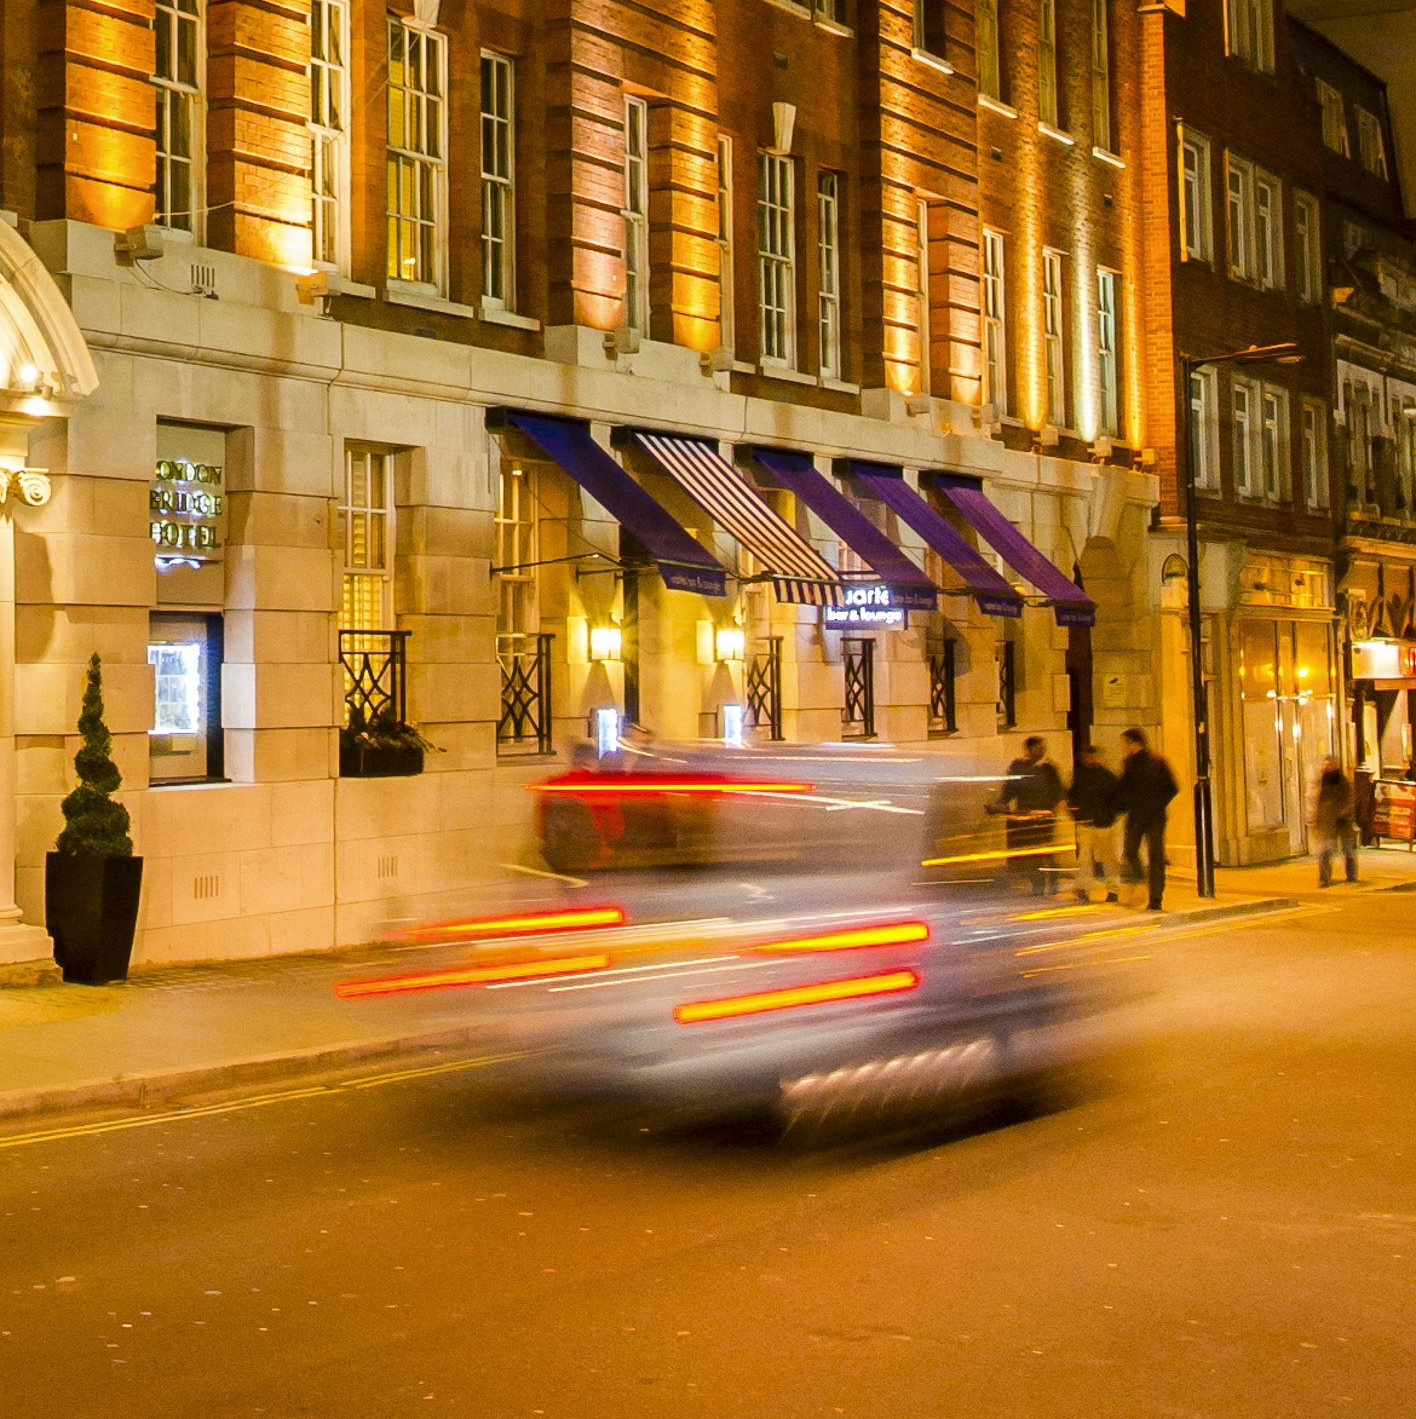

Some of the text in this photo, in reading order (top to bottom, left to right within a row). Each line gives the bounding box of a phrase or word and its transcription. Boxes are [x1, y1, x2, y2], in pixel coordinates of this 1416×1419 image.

[155, 460, 223, 485] ONDON
[149, 489, 223, 516] BRIDGE
[149, 521, 222, 549] HOTEL
[859, 606, 903, 625] lounge
